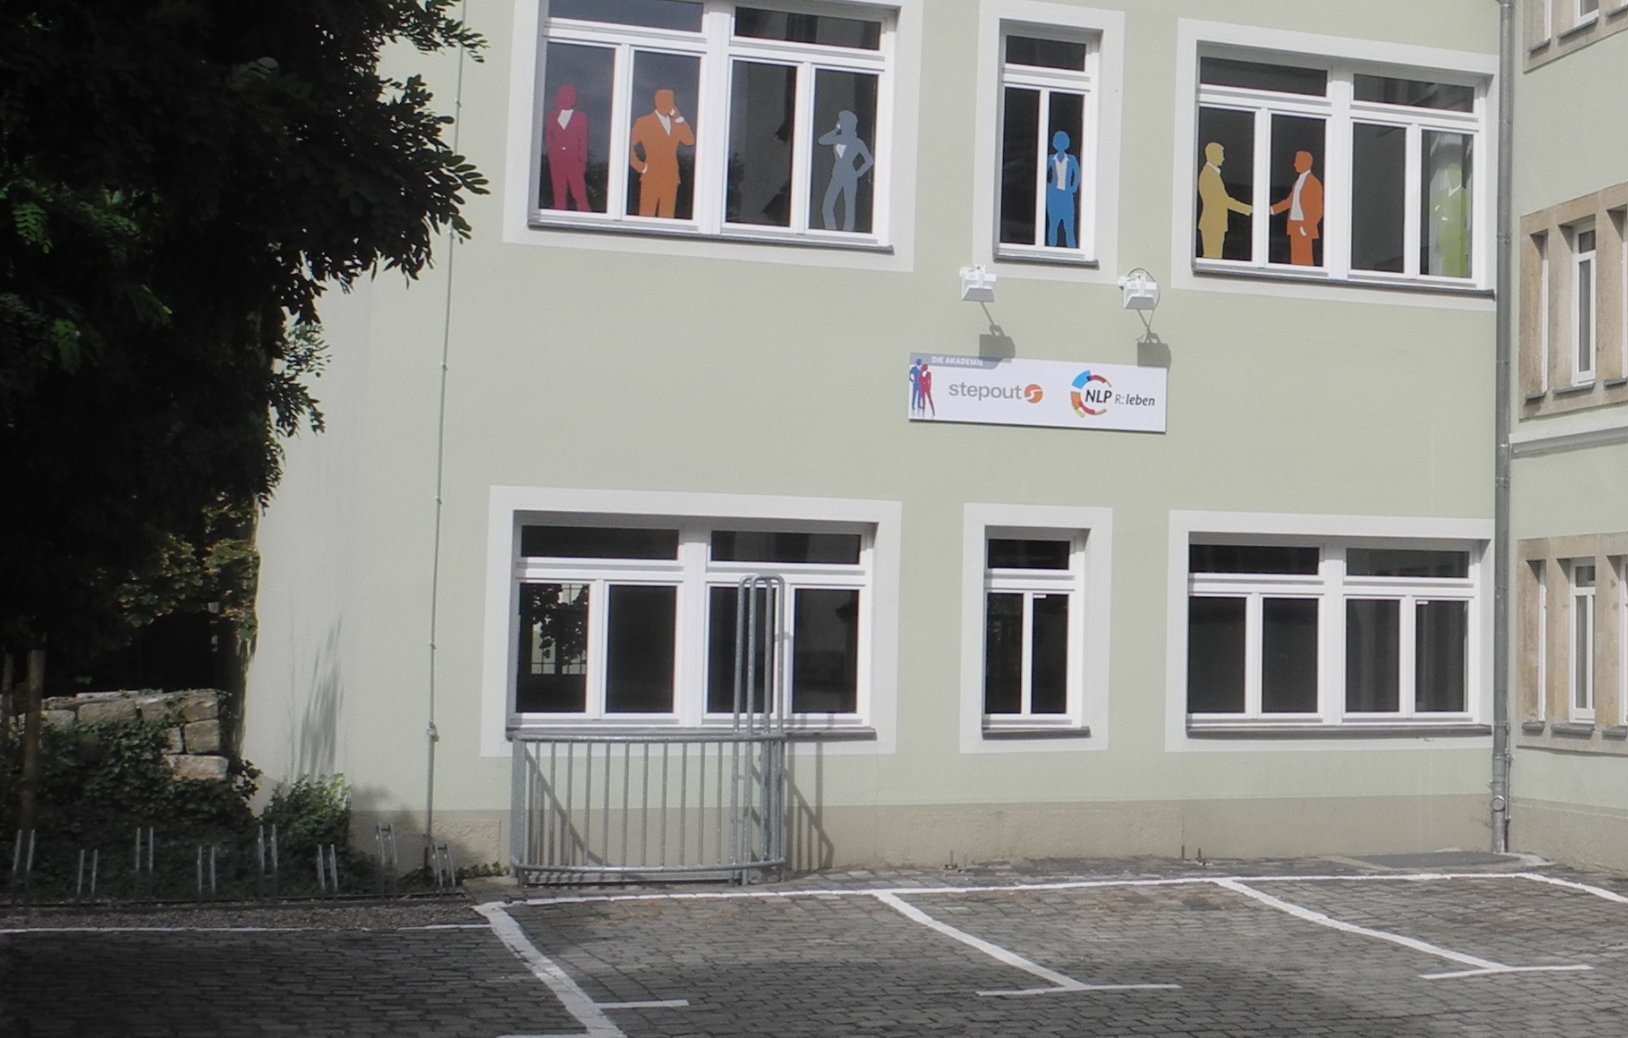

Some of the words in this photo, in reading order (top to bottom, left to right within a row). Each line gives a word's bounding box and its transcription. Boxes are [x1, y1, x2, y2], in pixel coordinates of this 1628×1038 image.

[931, 356, 945, 364] DIE
[948, 381, 1022, 401] stepout
[1085, 388, 1112, 404] NLP
